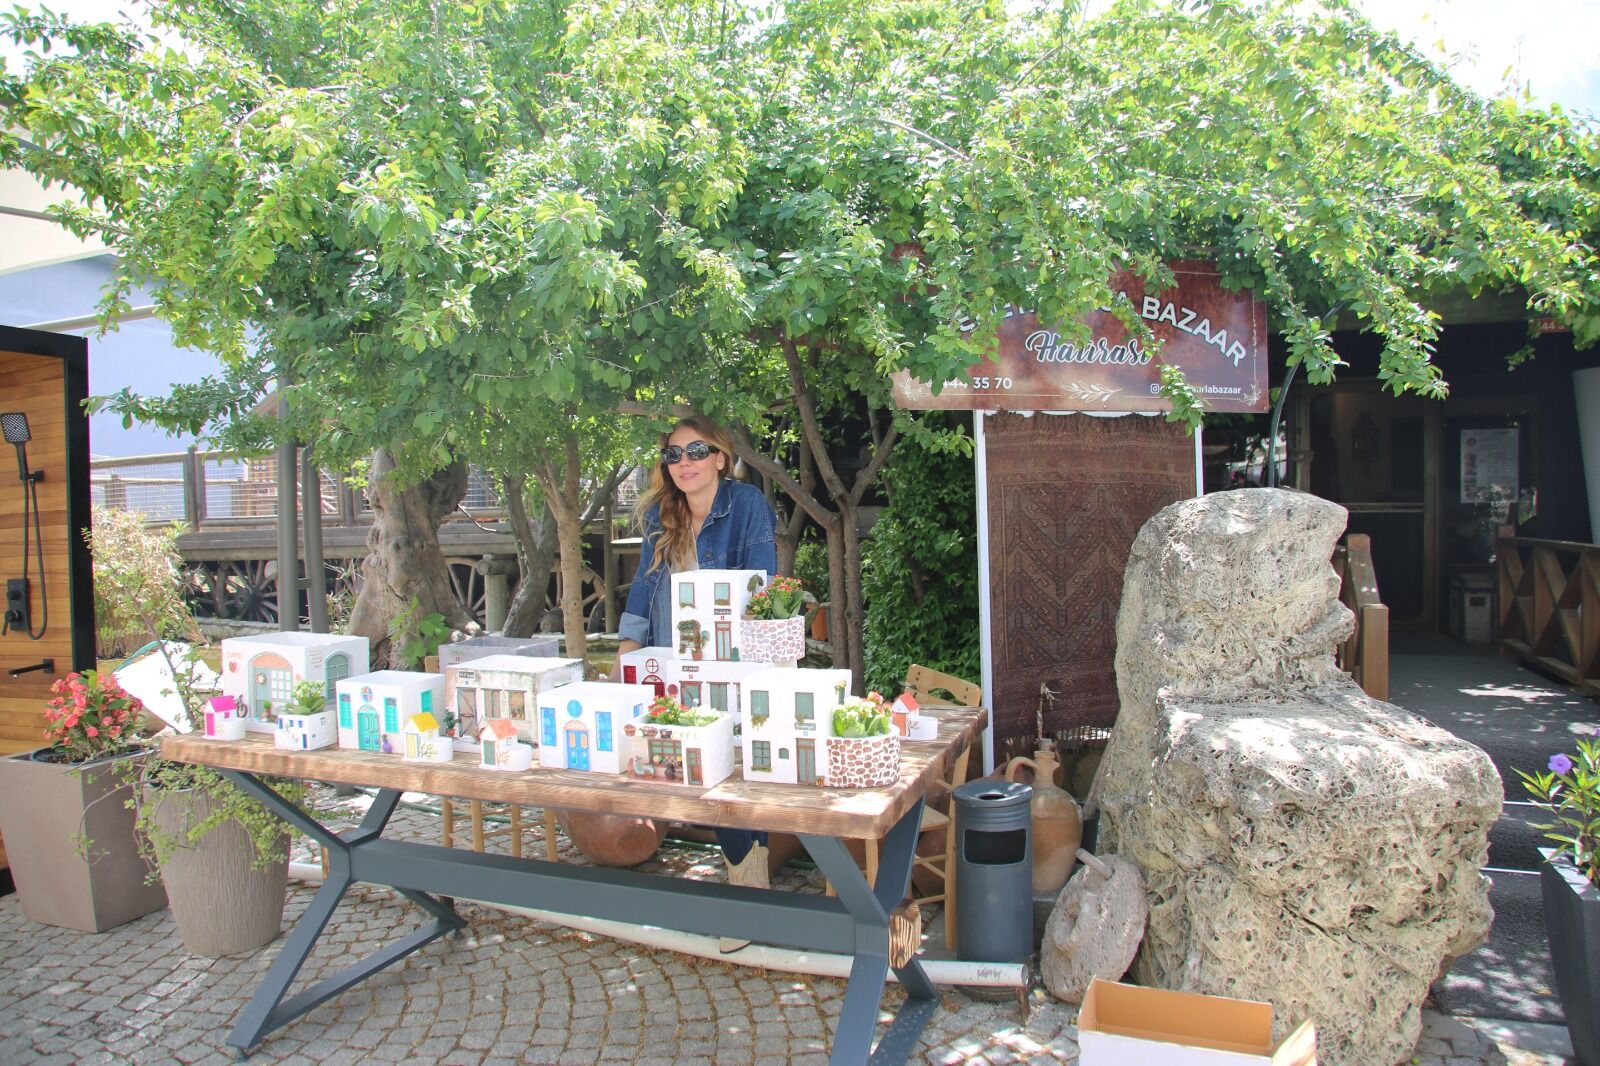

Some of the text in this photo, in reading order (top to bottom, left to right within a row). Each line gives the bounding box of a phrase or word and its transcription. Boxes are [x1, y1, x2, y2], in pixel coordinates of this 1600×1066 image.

[1142, 296, 1246, 367] BAZAAR
[973, 377, 990, 390] 35
[994, 377, 1013, 390] 70
